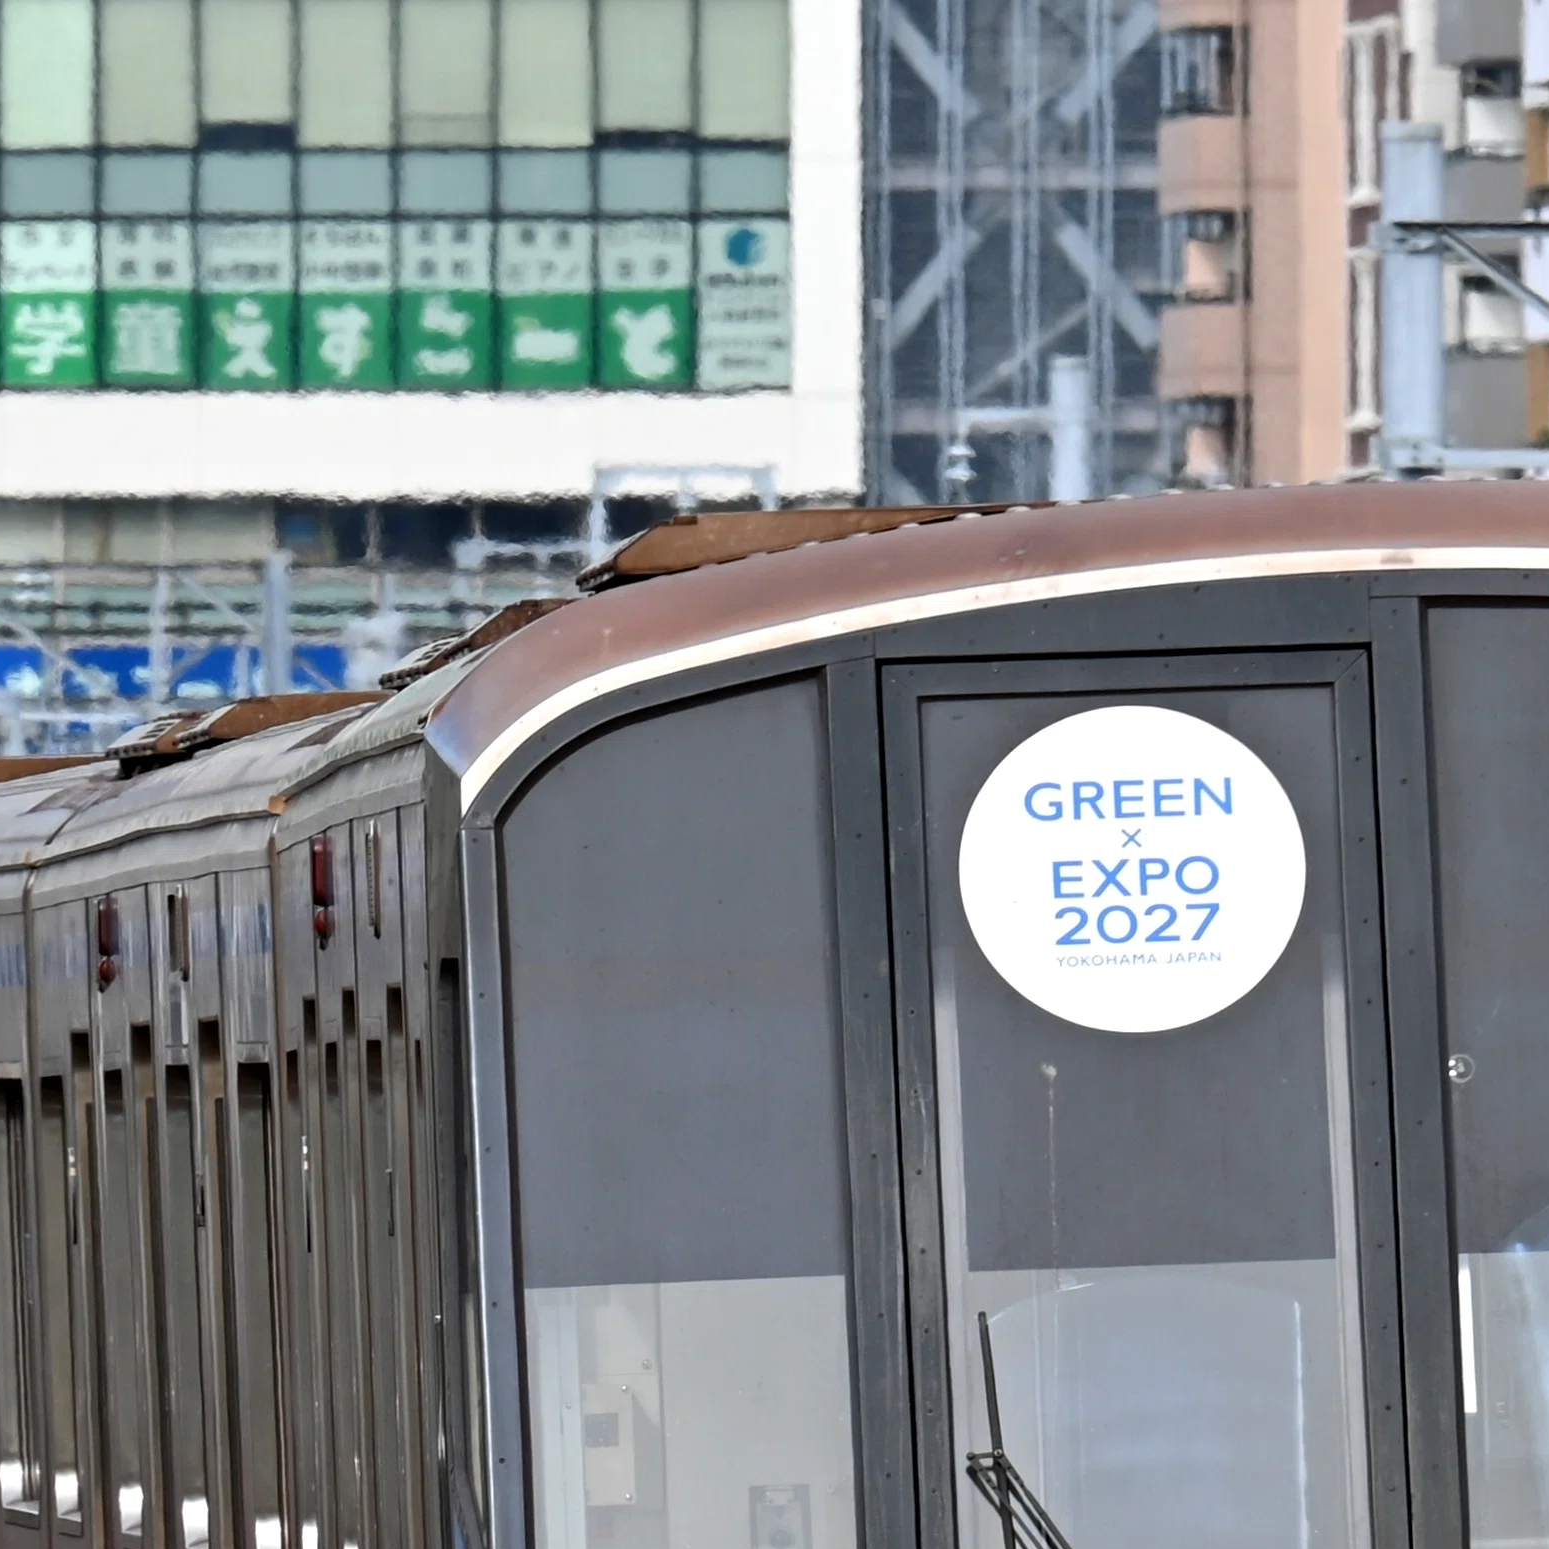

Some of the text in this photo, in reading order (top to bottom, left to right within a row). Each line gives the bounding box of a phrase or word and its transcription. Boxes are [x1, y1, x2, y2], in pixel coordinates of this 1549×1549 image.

[1023, 777, 1233, 822] GREEN
[1051, 855, 1220, 899] EXPO
[1054, 903, 1221, 946] 2027
[1056, 951, 1223, 968] YOKOHAMA JAPAN
